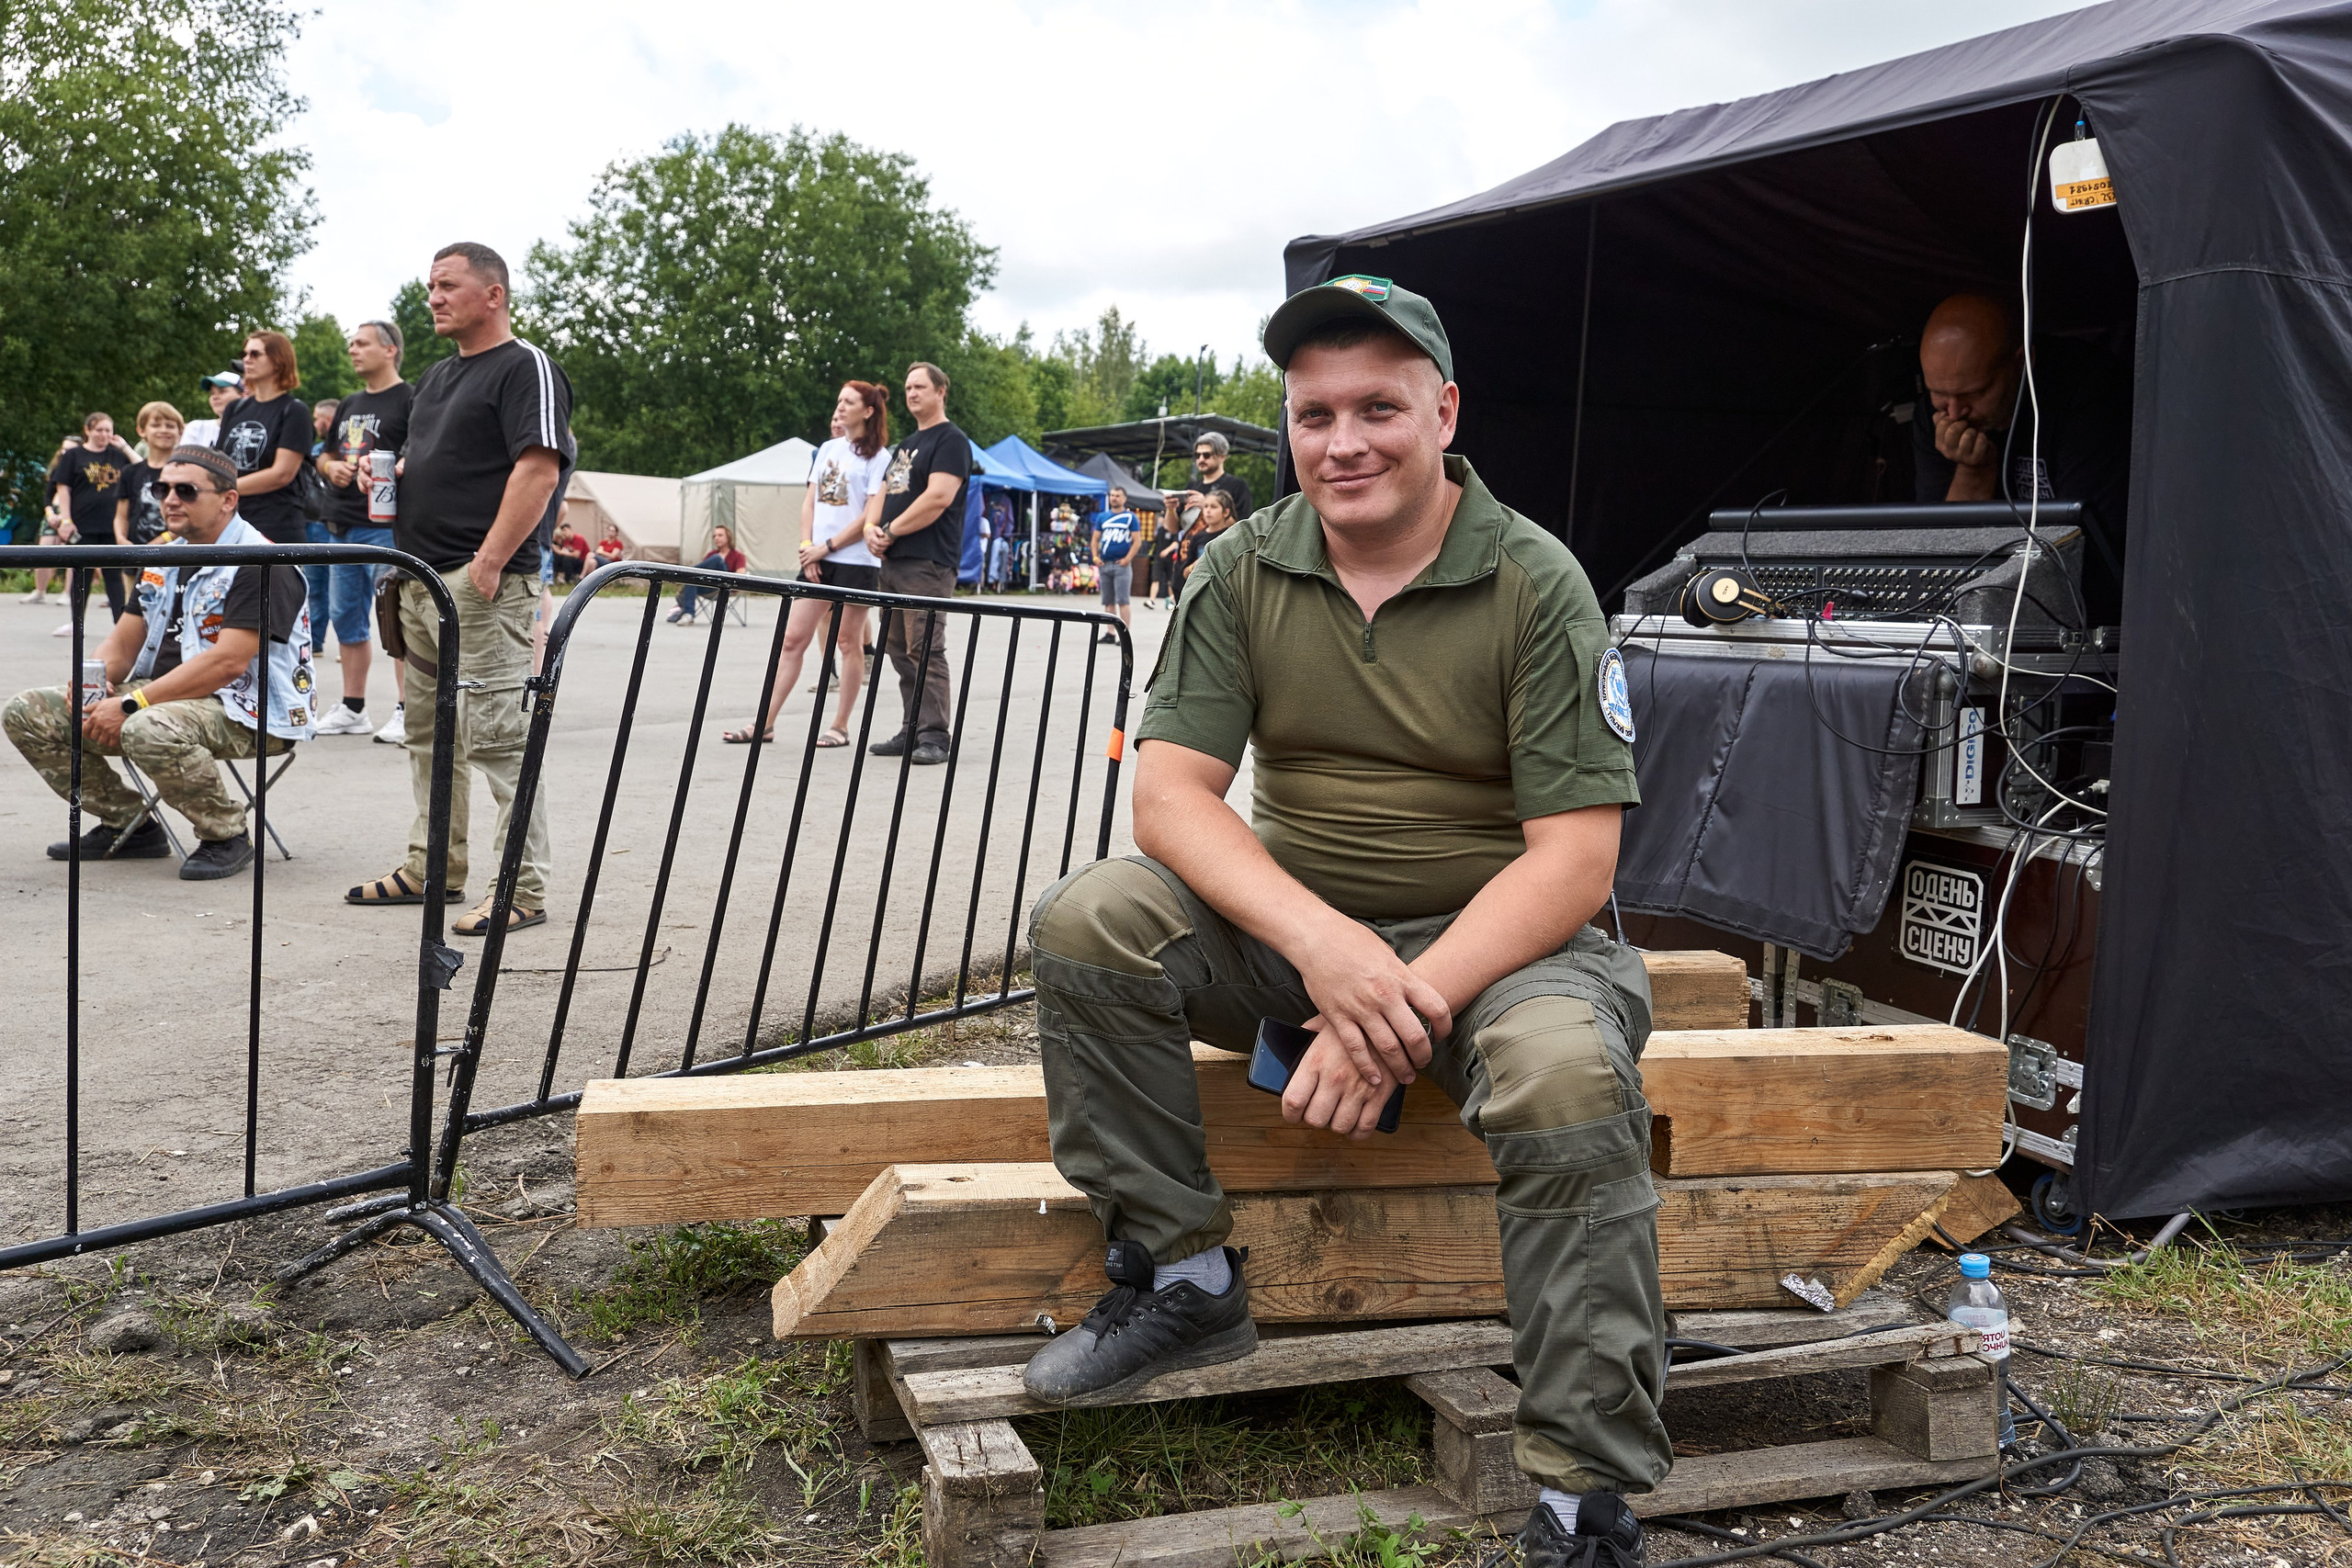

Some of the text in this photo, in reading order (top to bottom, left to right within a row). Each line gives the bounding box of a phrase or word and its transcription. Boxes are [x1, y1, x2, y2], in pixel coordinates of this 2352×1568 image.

[1911, 870, 1974, 908] ОДЕНЬ
[1907, 925, 1972, 965] СЦЕНУ
[1982, 1329, 2006, 1342] ЯТОЙ
[1983, 1338, 2008, 1352] ОЧНИК
